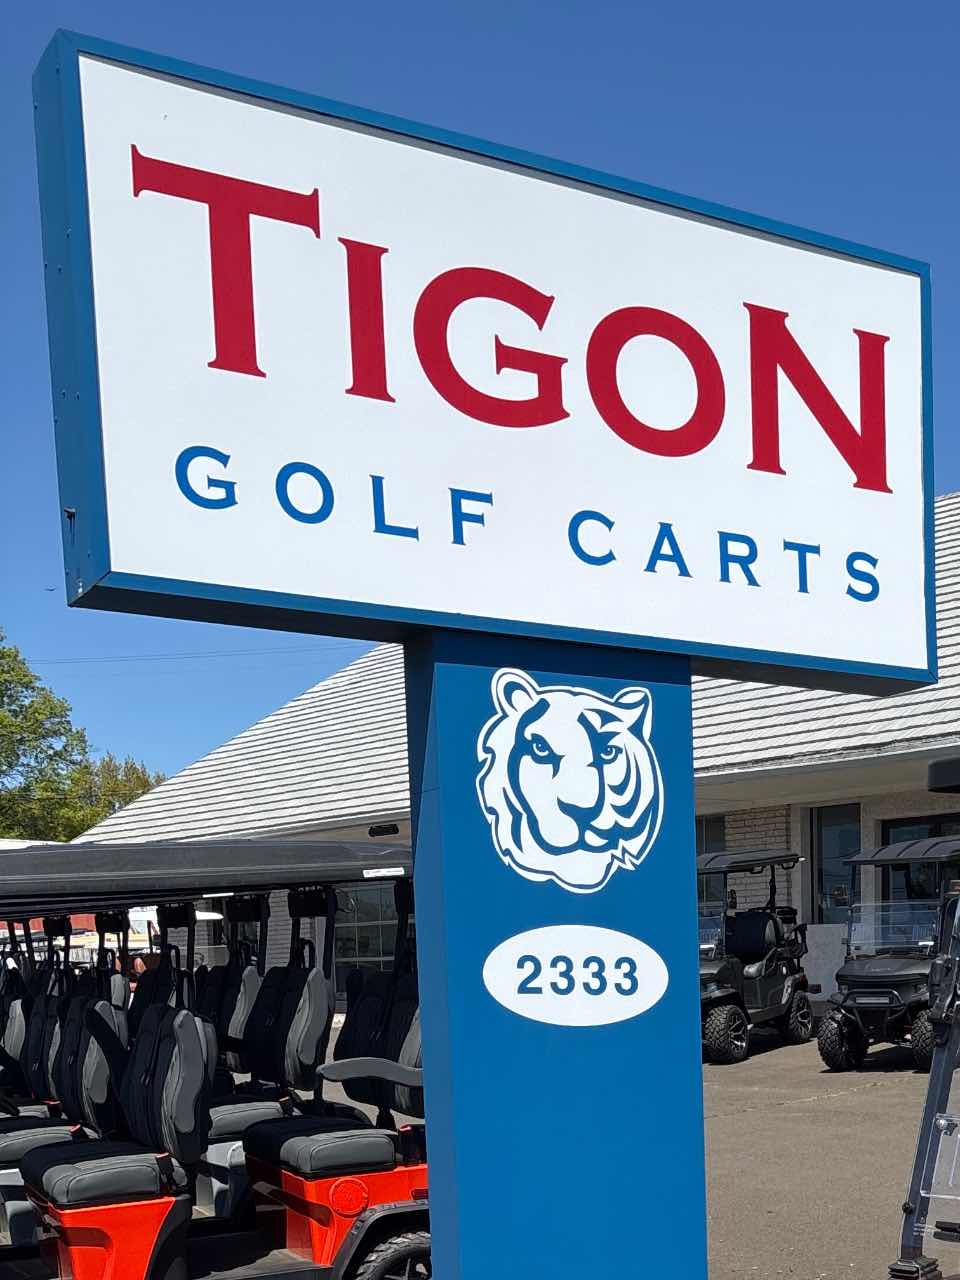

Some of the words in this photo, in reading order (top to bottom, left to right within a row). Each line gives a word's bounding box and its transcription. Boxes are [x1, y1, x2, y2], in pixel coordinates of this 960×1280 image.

[131, 143, 893, 493] TIGON
[175, 446, 492, 544] GOLF
[568, 510, 880, 602] CARTS
[517, 955, 638, 996] 2333
